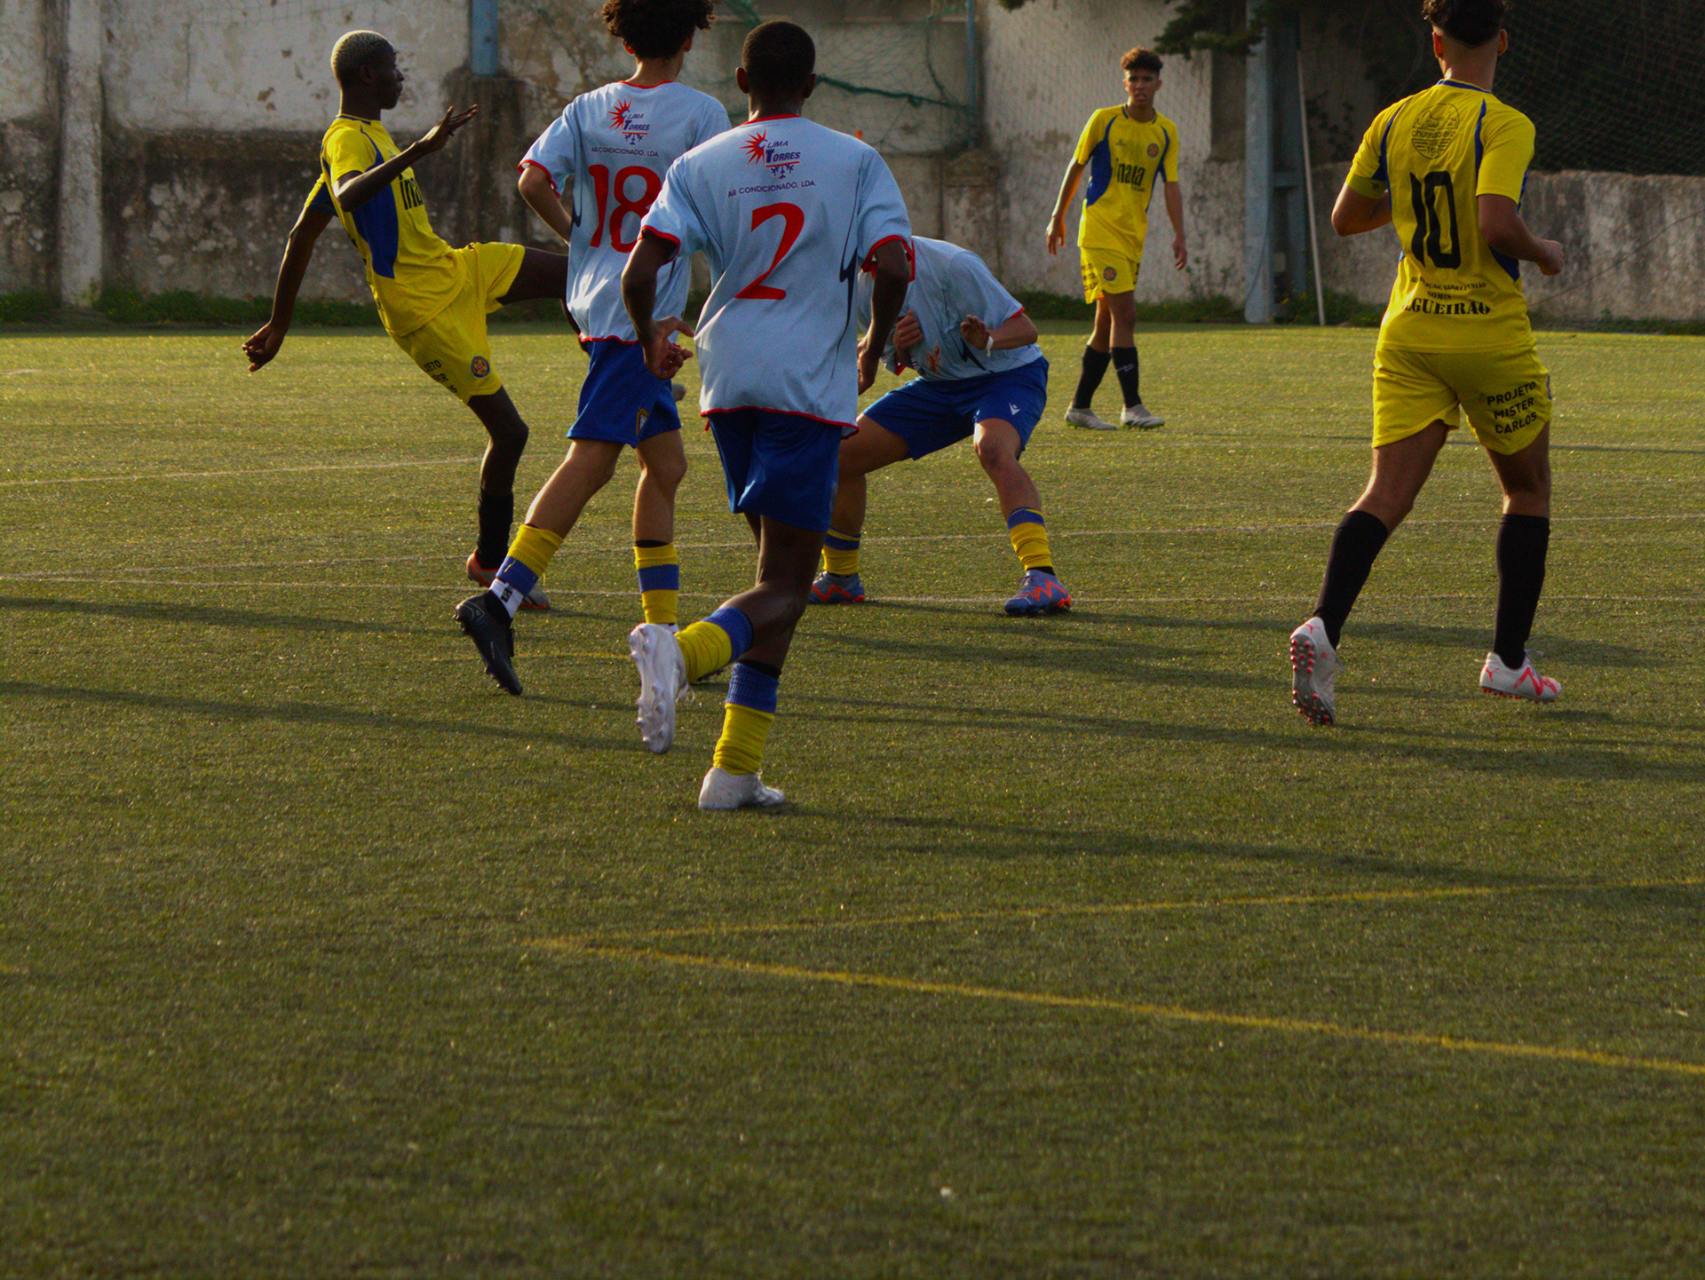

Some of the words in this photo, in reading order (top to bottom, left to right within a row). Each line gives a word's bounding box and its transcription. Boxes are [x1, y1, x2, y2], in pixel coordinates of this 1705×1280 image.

[765, 148, 801, 163] TORRES
[766, 140, 789, 149] LIMA
[588, 165, 662, 253] 18
[1410, 170, 1462, 269] 10
[736, 202, 805, 300] 2
[1487, 381, 1537, 406] PROJETO
[1494, 397, 1535, 419] MISTER
[1495, 412, 1537, 434] CARLOS
